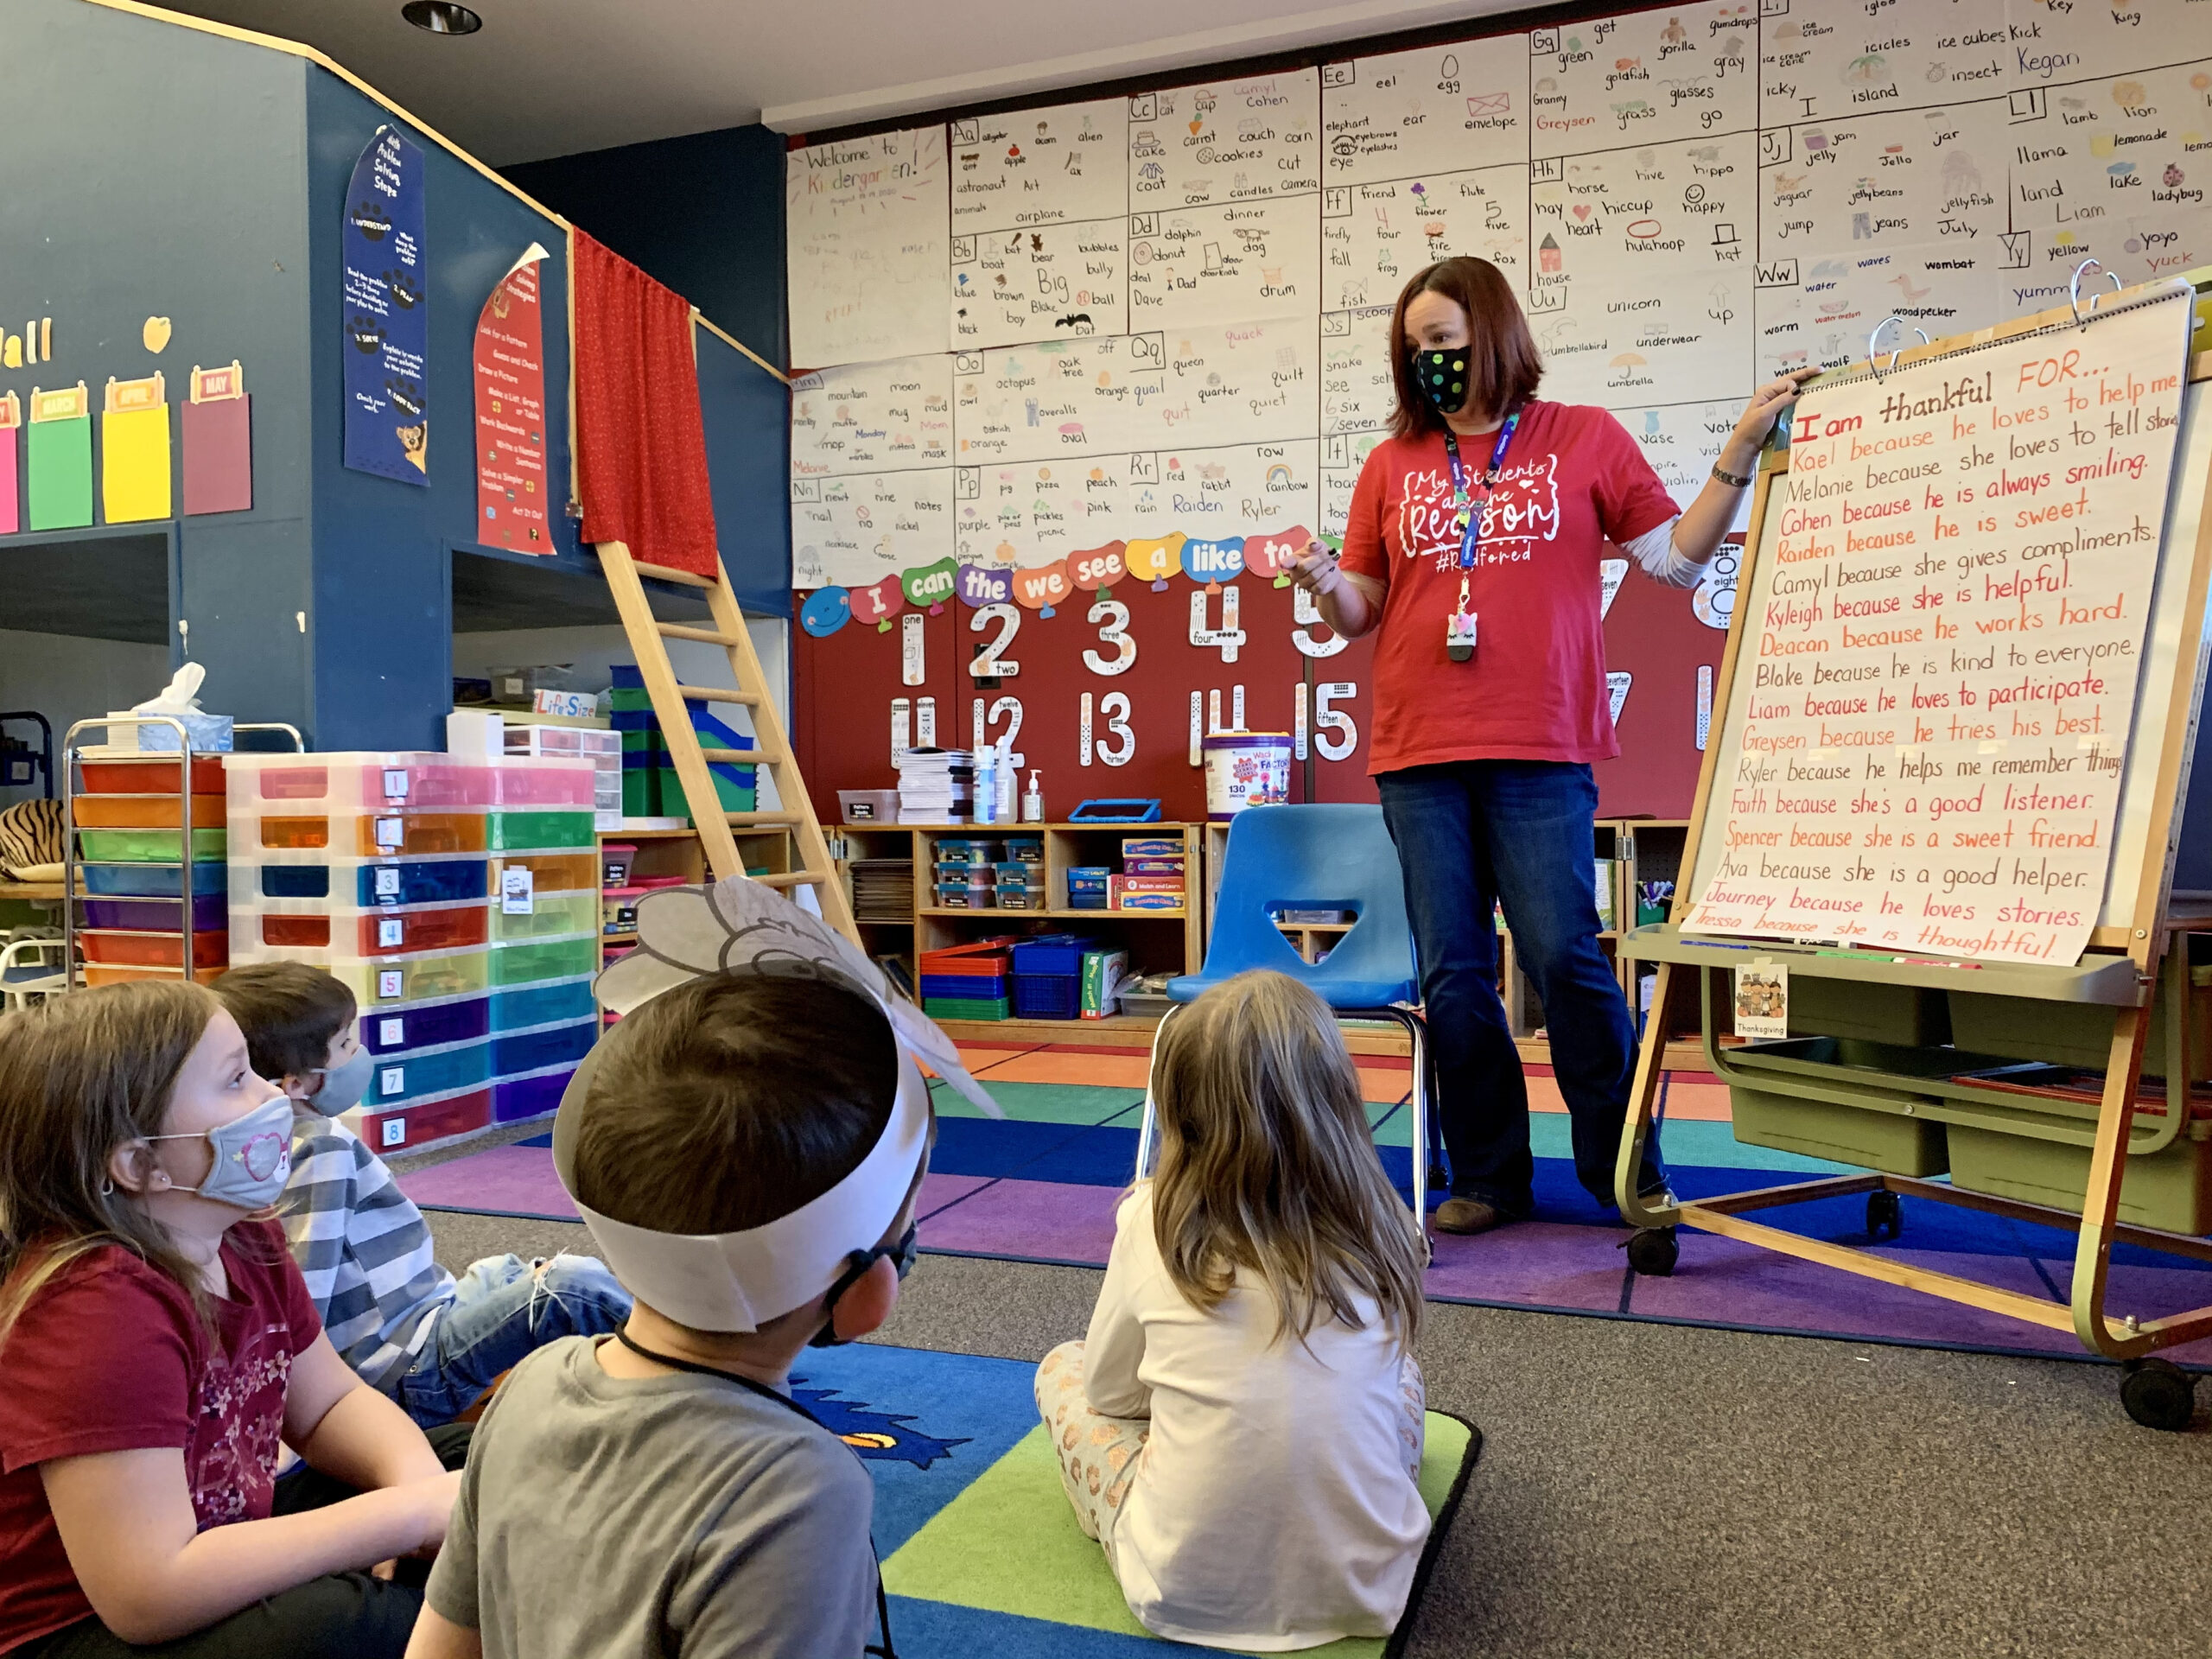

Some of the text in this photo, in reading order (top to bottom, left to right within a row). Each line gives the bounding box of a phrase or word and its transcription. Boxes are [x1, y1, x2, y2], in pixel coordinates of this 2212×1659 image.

[1657, 42, 1696, 60] gorilla
[1559, 51, 1593, 73] green
[2017, 48, 2080, 79] Kegan
[1324, 67, 1345, 83] Ee
[1952, 60, 2003, 81] insect
[1246, 96, 1288, 107] Cohen
[1670, 86, 1714, 107] glasses
[1465, 117, 1517, 130] envelope
[1536, 116, 1595, 132] Greysen
[1078, 132, 1103, 142] alien
[1183, 131, 1217, 146] carrot
[1238, 130, 1275, 142] couch
[2114, 129, 2167, 147] lemonade
[806, 139, 897, 168] Welcome to
[1214, 149, 1263, 163] cookies
[2018, 146, 2069, 165] llama
[374, 158, 400, 187] Solving
[374, 175, 397, 197] Steps
[957, 178, 1006, 193] astronaut
[1361, 187, 1396, 200] friend
[2152, 189, 2202, 206] ladybug
[1415, 207, 1446, 217] flower
[1602, 200, 1653, 215] hiccup
[1682, 200, 1725, 215] happy
[2056, 203, 2106, 223] Liam
[1016, 210, 1065, 223] airplane
[1936, 219, 1978, 238] July
[1079, 243, 1119, 252] bubbles
[1625, 239, 1685, 252] hulahoop
[1925, 259, 1976, 271] wombat
[1038, 268, 1070, 304] Big
[1260, 284, 1295, 296] drum
[400, 289, 414, 302] PLAN
[1092, 294, 1114, 304] ball
[1134, 290, 1163, 306] Dave
[1607, 298, 1661, 314] unicorn
[1892, 306, 1957, 320] woodpecker
[1708, 308, 1733, 325] up
[0, 318, 52, 368] all
[1637, 334, 1702, 347] underwear
[206, 377, 226, 394] MAY
[890, 382, 920, 392] moon
[995, 377, 1036, 390] octopus
[1607, 377, 1654, 388] umbrella
[1198, 386, 1240, 404] quarter
[1039, 405, 1077, 416] overalls
[1791, 415, 1821, 442] I
[1825, 413, 1862, 436] am
[1879, 371, 1991, 424] thankful
[1794, 448, 1836, 473] Kael
[1851, 429, 1935, 458] because
[1953, 415, 1975, 436] he
[1992, 405, 2050, 429] loves
[2064, 390, 2088, 412] to
[2100, 379, 2143, 406] help
[1062, 432, 1087, 444] oval
[1785, 477, 1853, 505] Melanie
[1866, 461, 1942, 488] because
[1960, 444, 1995, 470] she
[2009, 435, 2059, 461] loves
[2069, 420, 2095, 447] to
[2109, 408, 2138, 437] tell
[1267, 480, 1308, 493] rainbow
[1415, 469, 1449, 496] My
[1781, 448, 2148, 536] Cohen because he is always smiling.
[1173, 492, 1224, 512] Raiden
[1242, 499, 1281, 522] Ryler
[1777, 487, 2092, 565] Raiden because he is sweet.
[1773, 515, 2156, 598] Camyl because she gives compliments.
[867, 541, 1293, 613] I can the we see a like to
[1714, 575, 1738, 588] eight
[1765, 561, 2072, 632] Kyleigh because she is helpful.
[969, 602, 1020, 677] 2
[1083, 600, 1136, 675] 3
[1189, 586, 1246, 664] 4
[1760, 593, 2126, 658] Deacan because he works hard.
[1101, 630, 1119, 639] three
[1194, 632, 1213, 643] four
[995, 664, 1015, 674] two
[1756, 638, 2135, 689] Blake because he is kind to everyone.
[1749, 670, 2108, 721] Liam because he loves to participate.
[1079, 683, 1357, 766] 13 15
[1318, 712, 1338, 723] fifteen
[1738, 757, 1777, 787] Ryler
[1787, 753, 1850, 781] because
[1866, 753, 1885, 779] he
[1900, 750, 1942, 784] helps
[1956, 760, 1982, 777] me
[1993, 743, 2075, 775] remember
[384, 875, 392, 889] 3
[1695, 906, 1743, 929] Tressa
[1754, 908, 1819, 934] because
[1833, 916, 1866, 937] she
[1881, 924, 1898, 941] is
[387, 926, 396, 940] 4
[386, 977, 395, 991] 5
[1738, 1023, 1784, 1035] Thanksgiving
[389, 1074, 397, 1090] 7
[390, 1126, 398, 1142] 8
